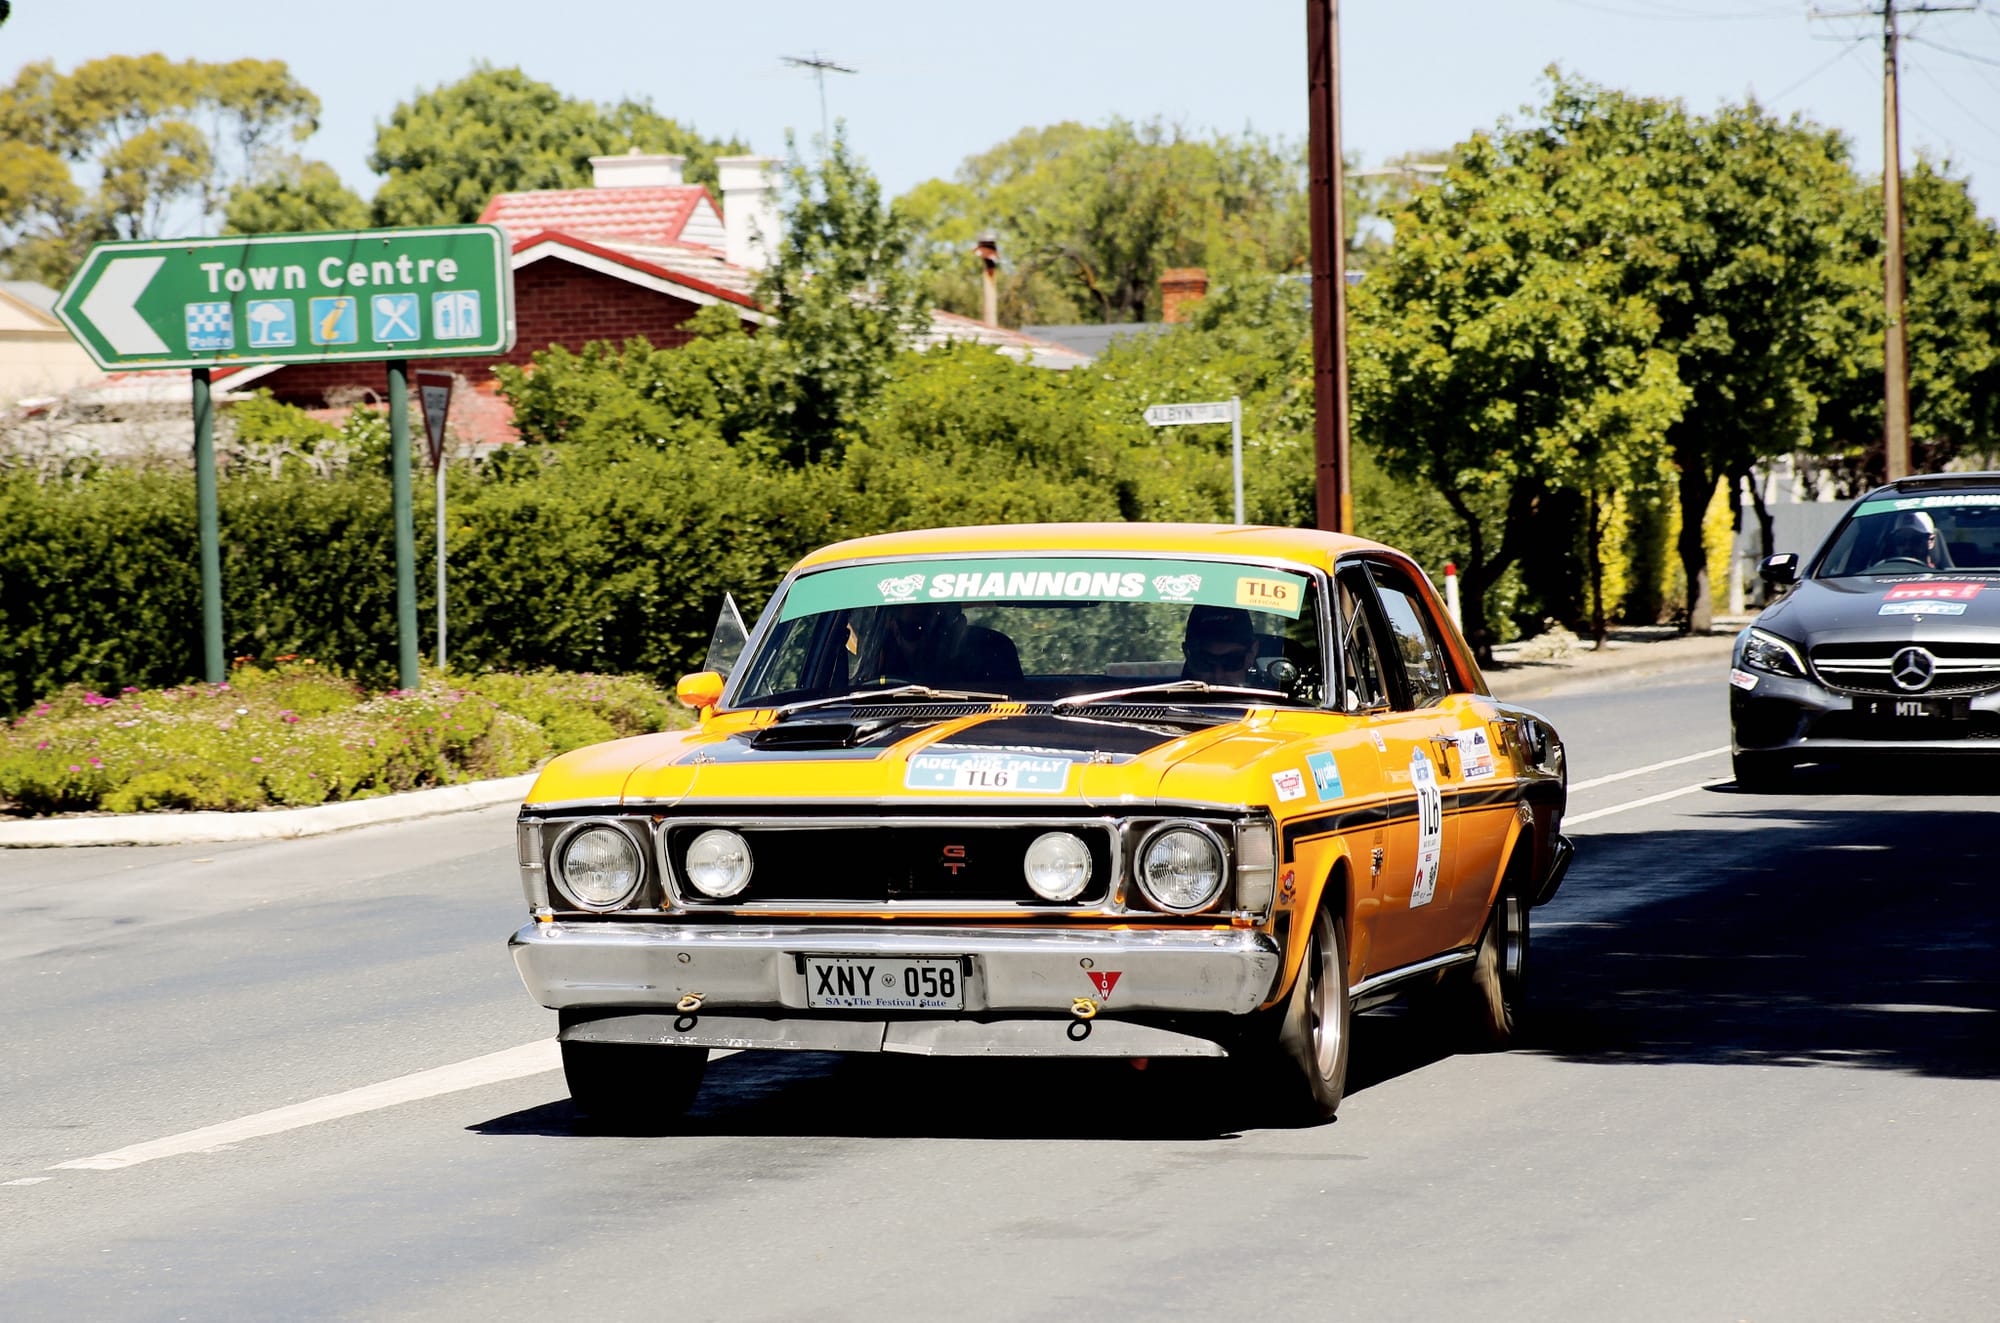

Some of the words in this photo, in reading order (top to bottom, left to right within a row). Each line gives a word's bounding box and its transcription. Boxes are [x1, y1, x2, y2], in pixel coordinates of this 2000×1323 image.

[200, 262, 307, 293] Town
[318, 254, 458, 288] Centre
[1152, 407, 1193, 421] ALBYN
[928, 571, 1144, 598] SHANNONS
[1246, 582, 1286, 599] TL6
[1896, 701, 1929, 716] MTL
[915, 757, 1002, 770] ADELAIDE
[1006, 759, 1063, 772] RALLY
[967, 770, 1008, 787] TL6
[1419, 786, 1438, 836] TL6
[815, 965, 875, 996] XNY
[904, 967, 955, 998] 058
[1101, 972, 1109, 997] TOW
[852, 997, 871, 1006] The
[876, 998, 916, 1007] Festival
[920, 999, 946, 1007] State
